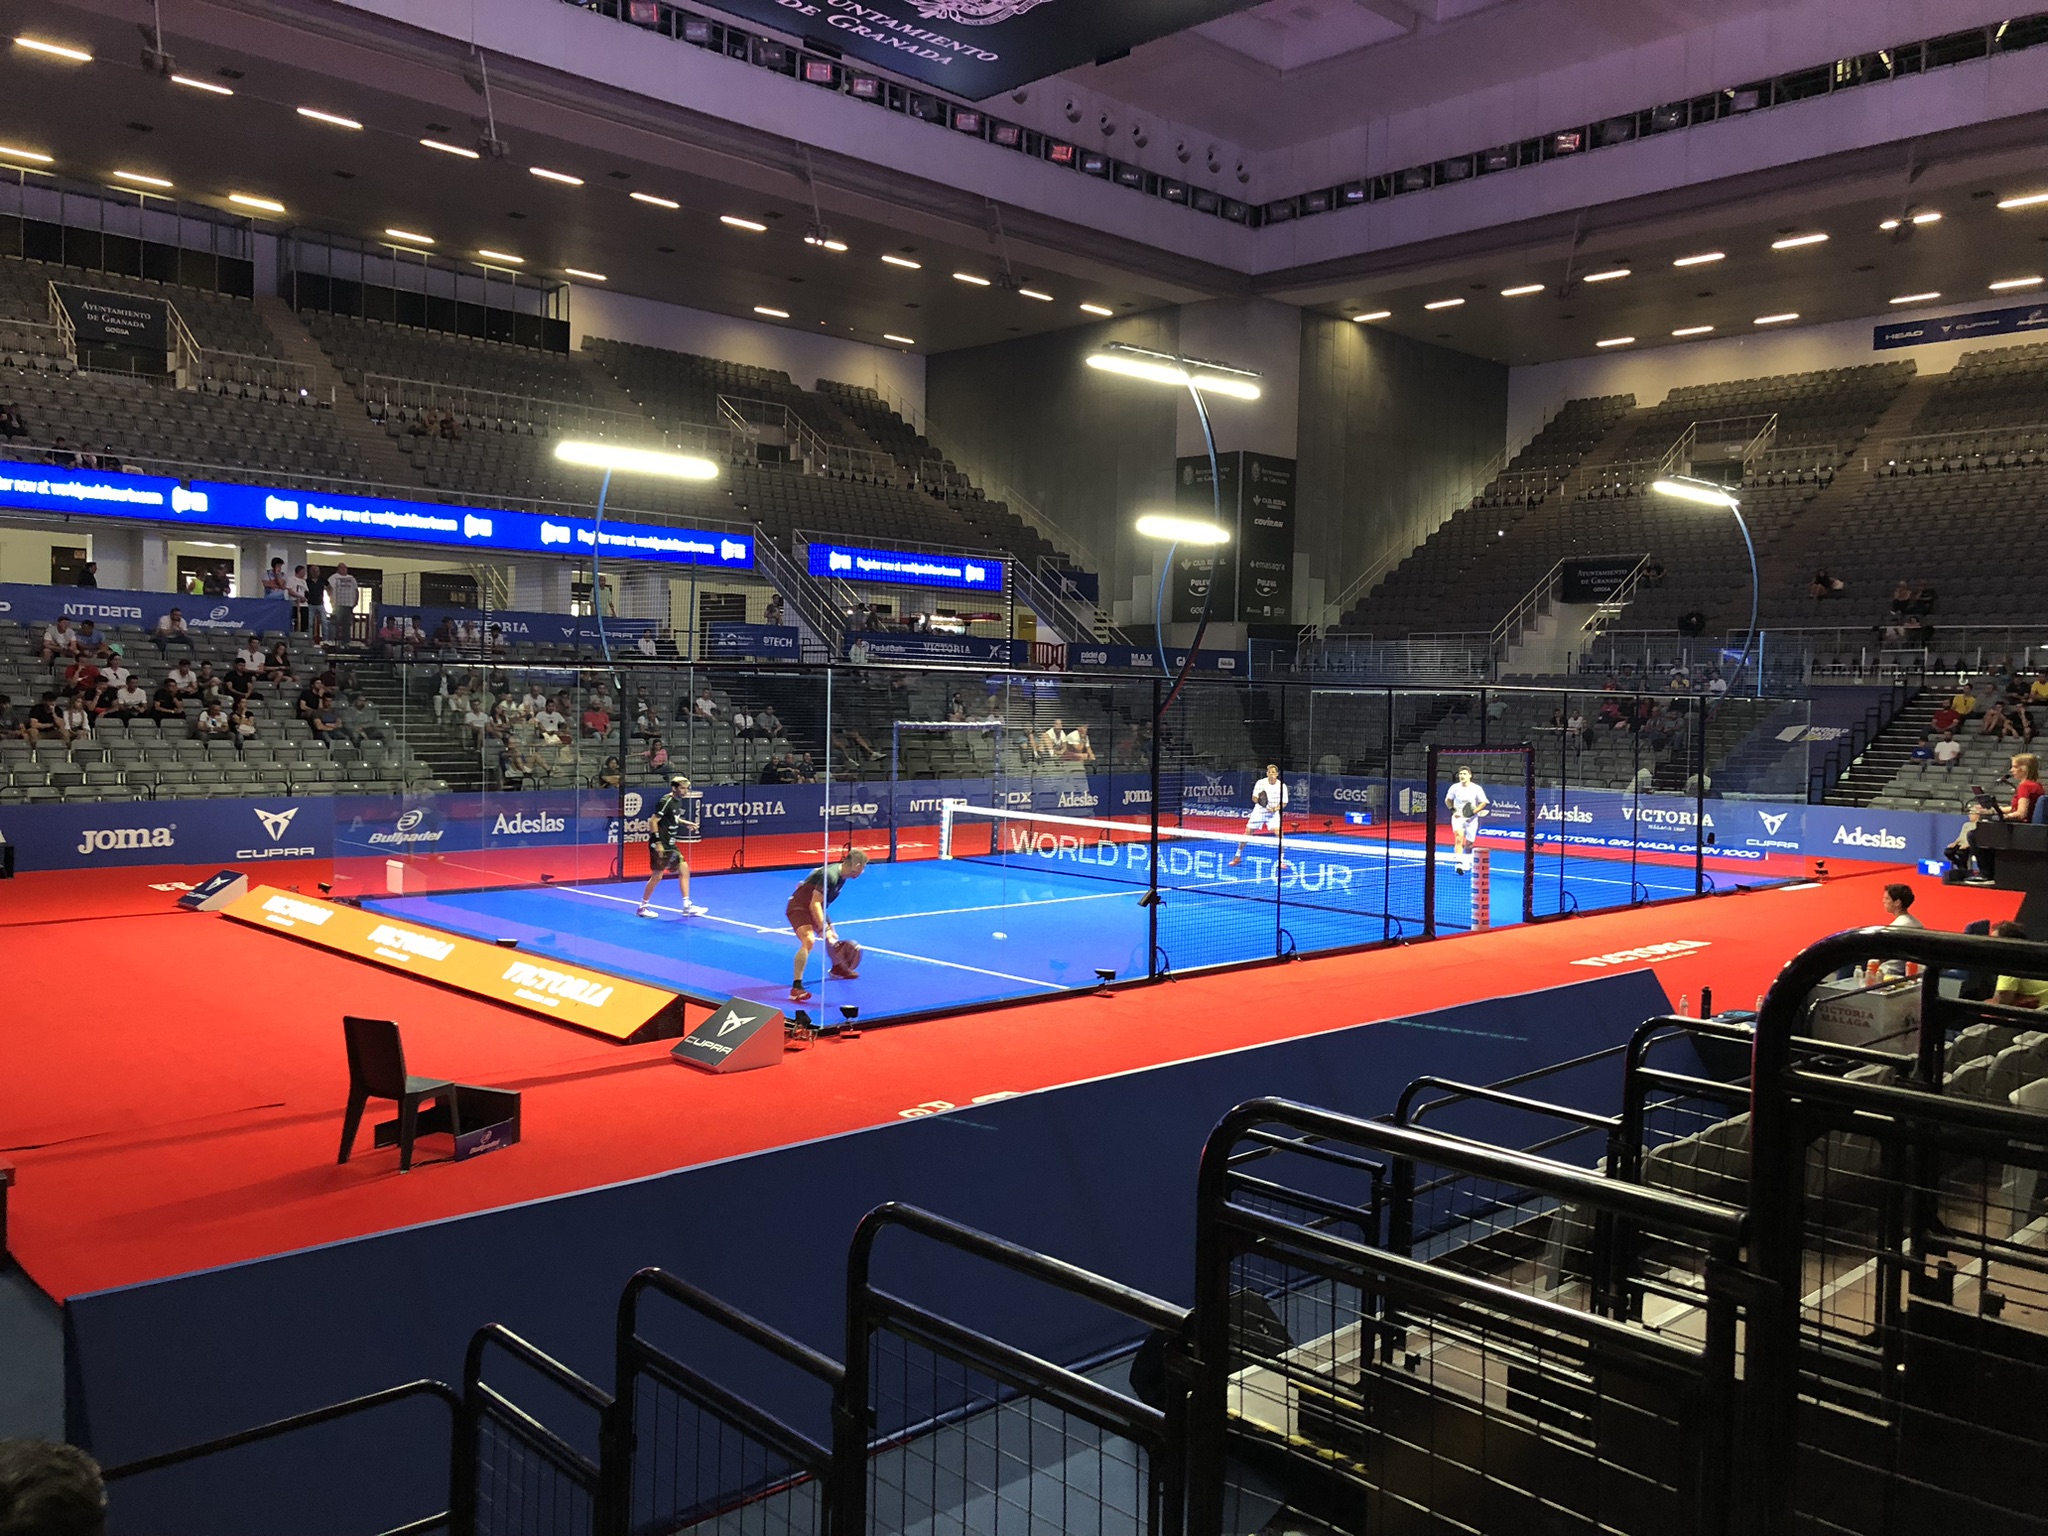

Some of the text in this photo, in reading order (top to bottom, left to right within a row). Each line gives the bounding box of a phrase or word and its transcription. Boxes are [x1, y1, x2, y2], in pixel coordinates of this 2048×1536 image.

[827, 14, 953, 65] GRANADA
[82, 301, 151, 320] AYUNTAMIENTO
[101, 313, 145, 329] GRANADA
[1885, 330, 1923, 341] HEAD
[189, 618, 245, 629] Bullpadel
[1131, 653, 1152, 661] MAX
[910, 799, 934, 812] NTT
[1057, 791, 1098, 808] Adeslas
[819, 803, 878, 816] HEAD
[1537, 804, 1593, 824] Adeslas
[492, 810, 565, 835] Adeslas
[368, 830, 444, 845] Bullpadel
[1746, 838, 1799, 850] CUPRA
[1833, 825, 1906, 850] Adeslas
[236, 847, 315, 859] CUPRA
[1547, 834, 1606, 845] VICTORIA
[1722, 849, 1760, 859] 1000
[1011, 828, 1352, 895] WORLD PADEL TOUR
[502, 961, 614, 1008] VICTORIA
[684, 1035, 733, 1055] CUPRA
